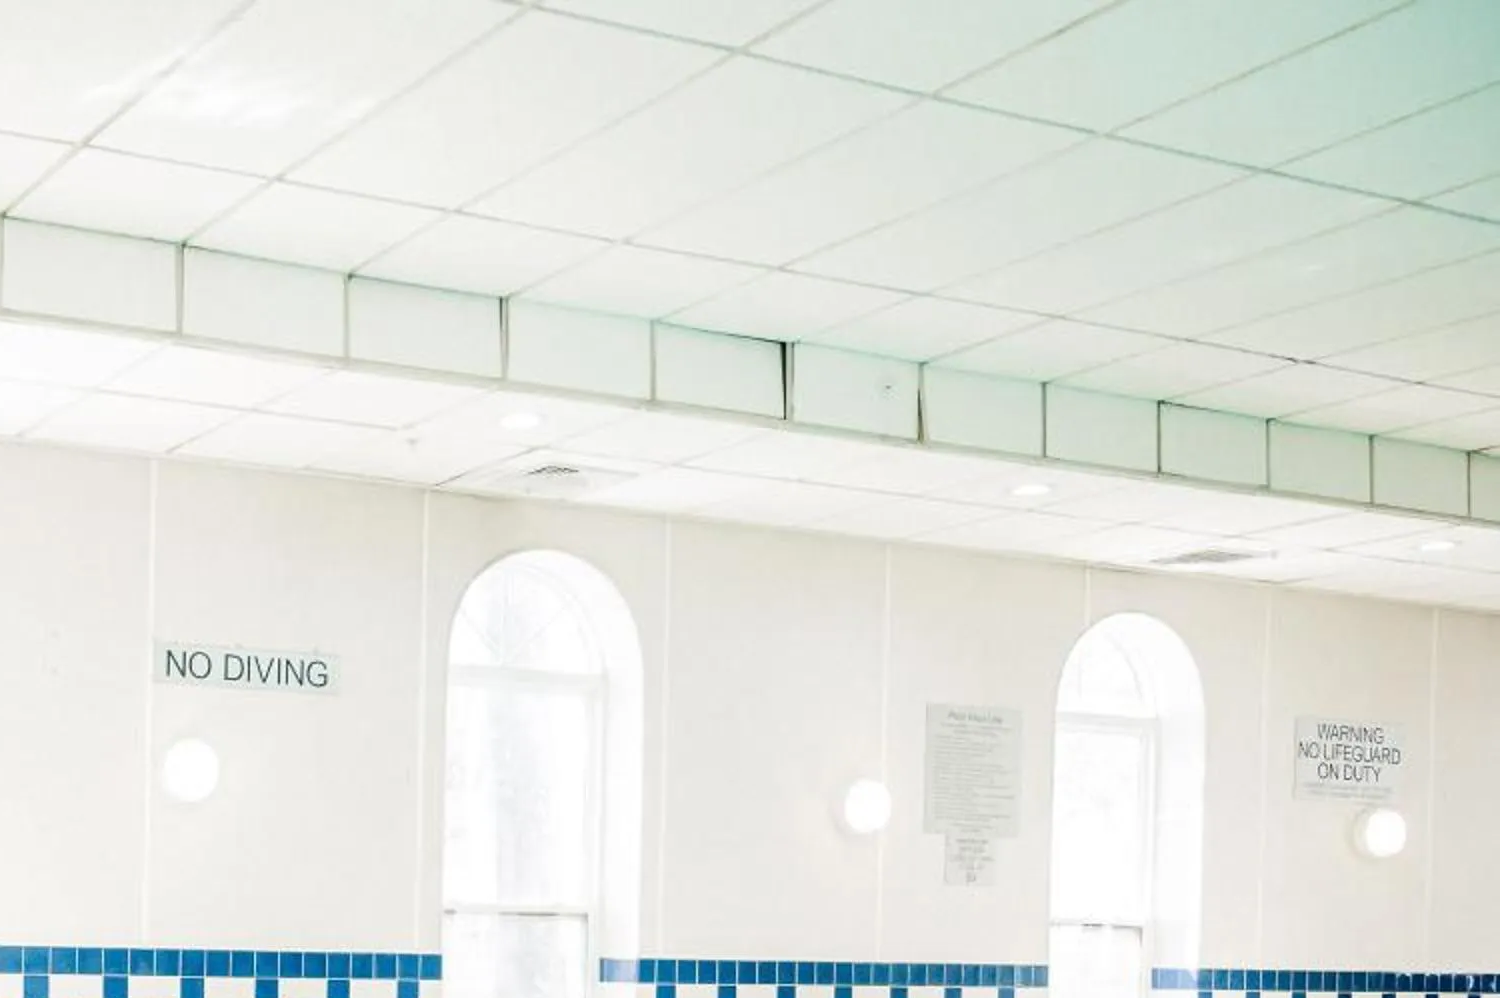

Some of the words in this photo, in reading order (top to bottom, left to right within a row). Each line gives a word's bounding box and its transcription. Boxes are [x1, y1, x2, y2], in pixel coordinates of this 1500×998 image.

[165, 649, 213, 680] NO
[223, 653, 329, 688] DIVING
[1317, 723, 1385, 745] WARNING
[1298, 741, 1320, 759] NO
[1323, 743, 1402, 765] LIFEGUARD
[1317, 761, 1339, 780] ON
[1343, 763, 1381, 782] DUTY
